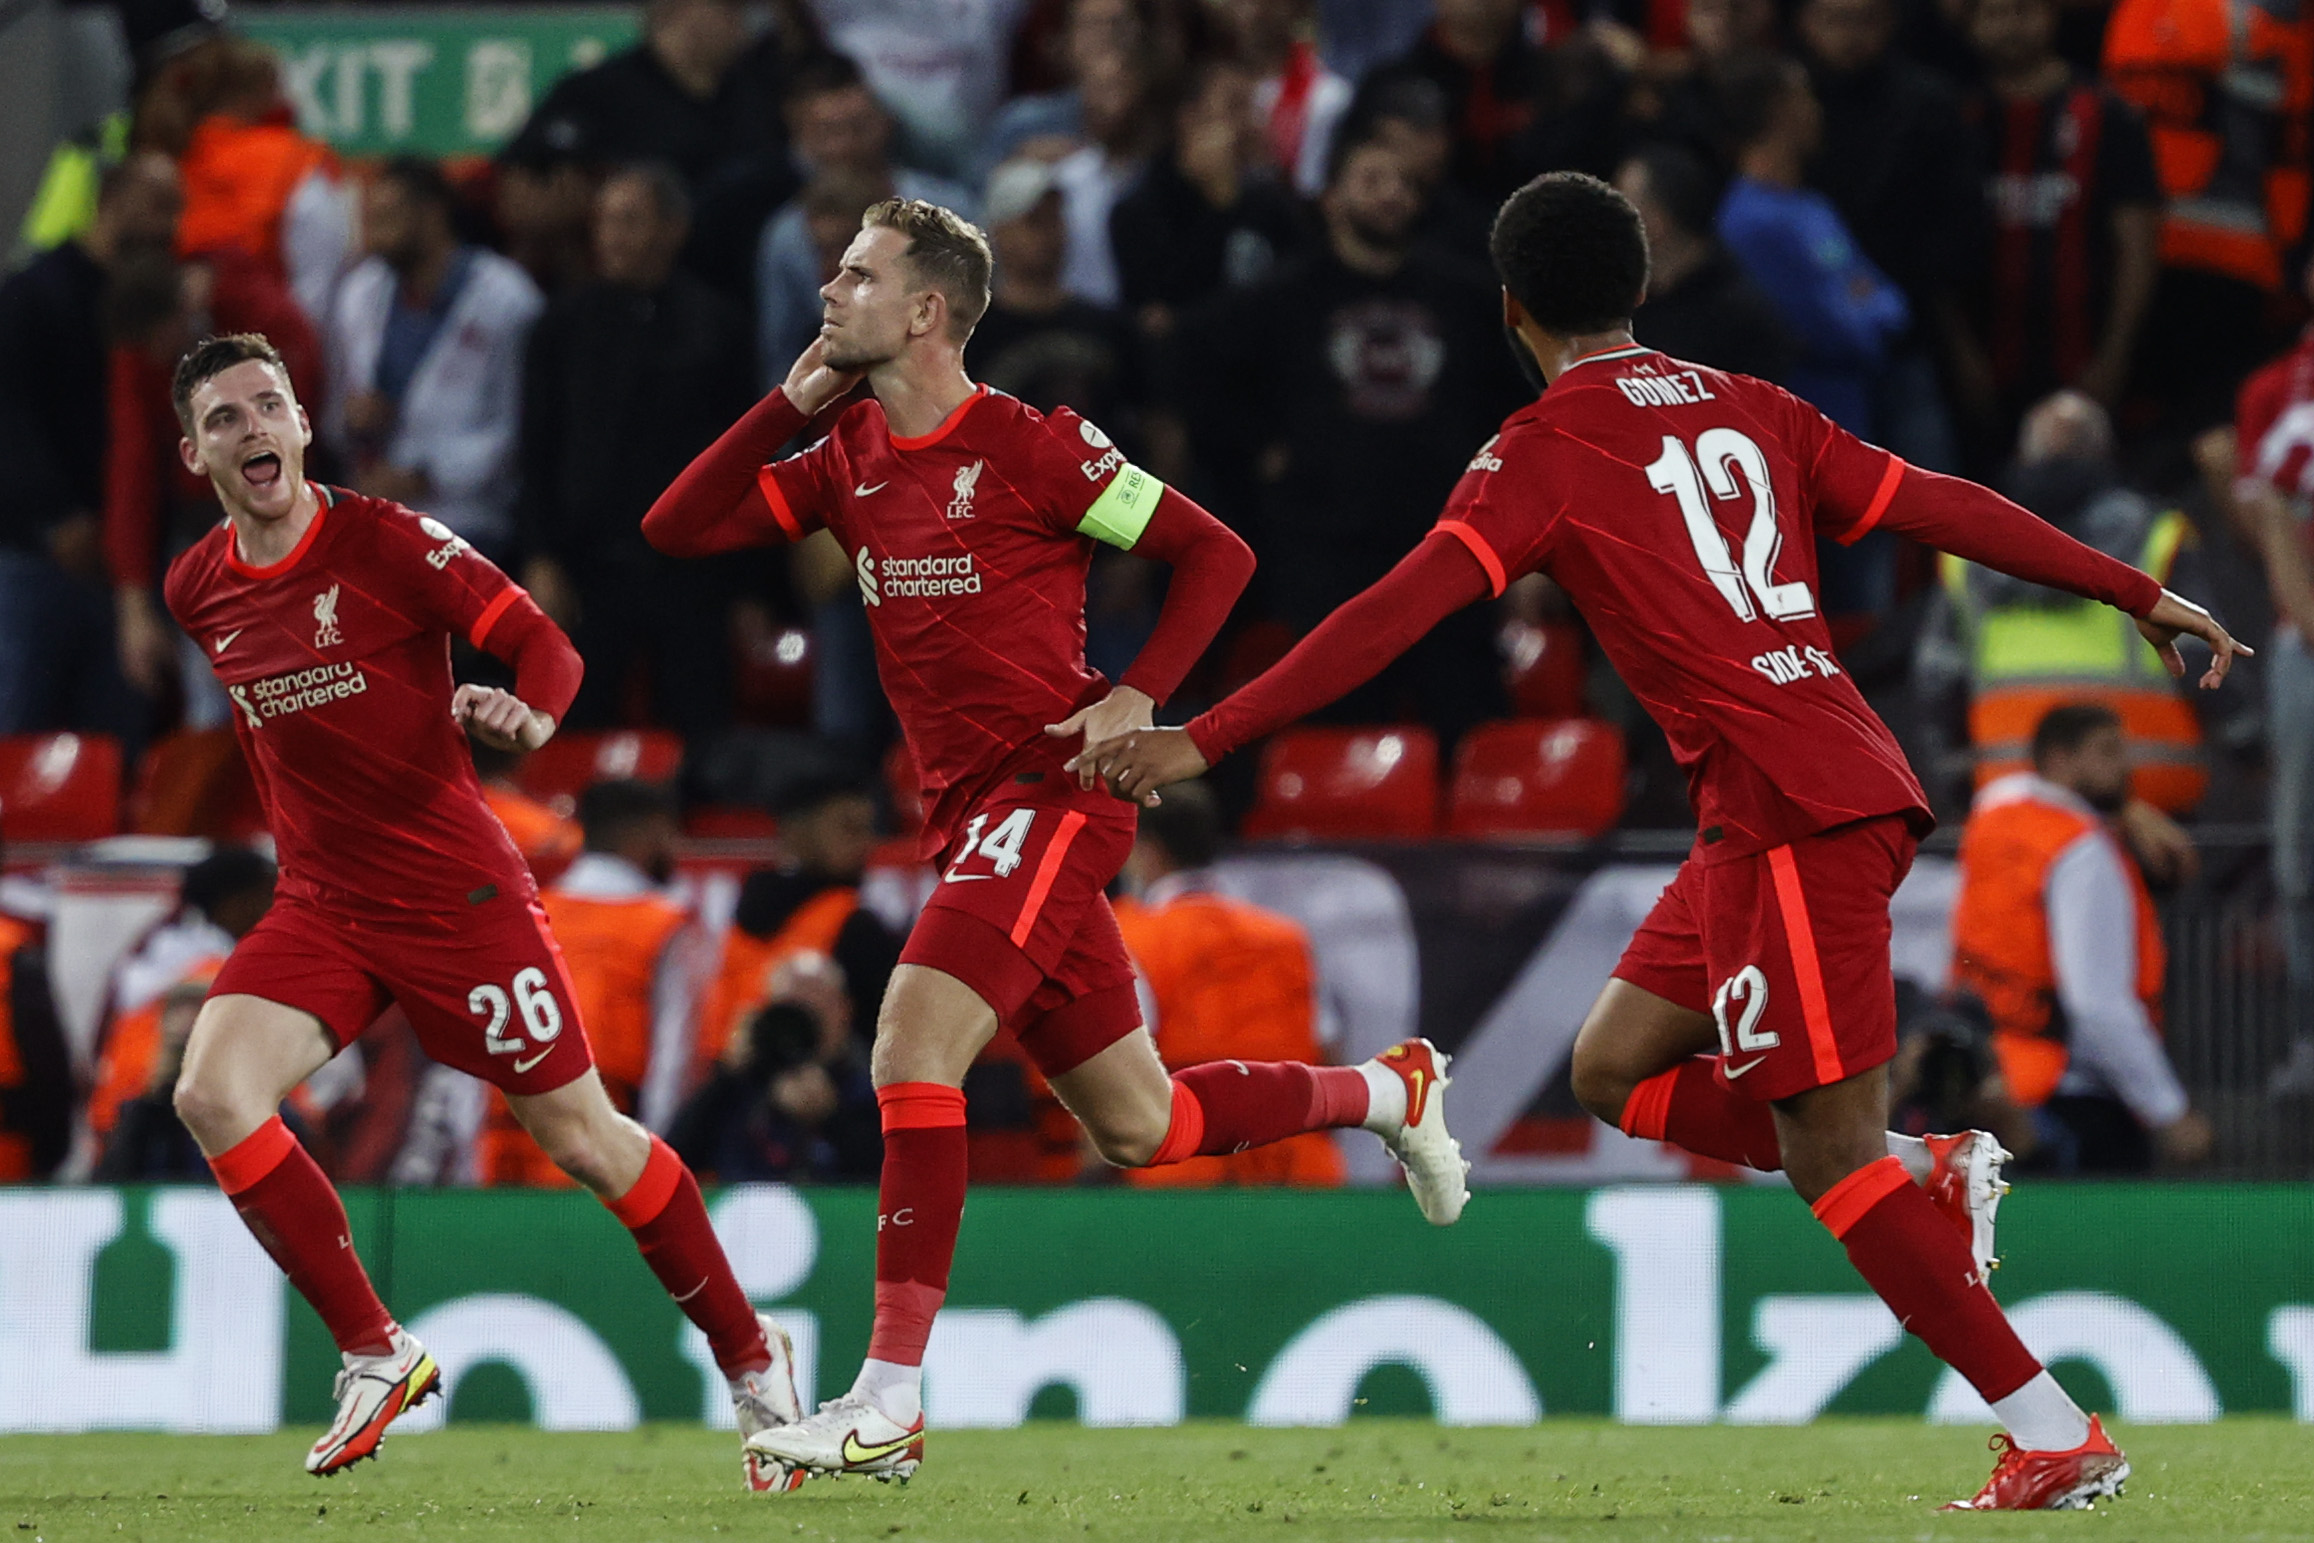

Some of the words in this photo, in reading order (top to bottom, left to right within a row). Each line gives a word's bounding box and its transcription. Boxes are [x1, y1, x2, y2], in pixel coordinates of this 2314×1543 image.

[279, 38, 432, 140] XIT
[1615, 370, 1716, 407] GOMEZ
[1644, 427, 1817, 623] 12
[881, 553, 972, 577] standard
[883, 573, 982, 598] chartered
[259, 671, 368, 718] chartered
[954, 808, 1037, 878] 14
[467, 966, 563, 1055] 26
[1712, 964, 1780, 1056] 12
